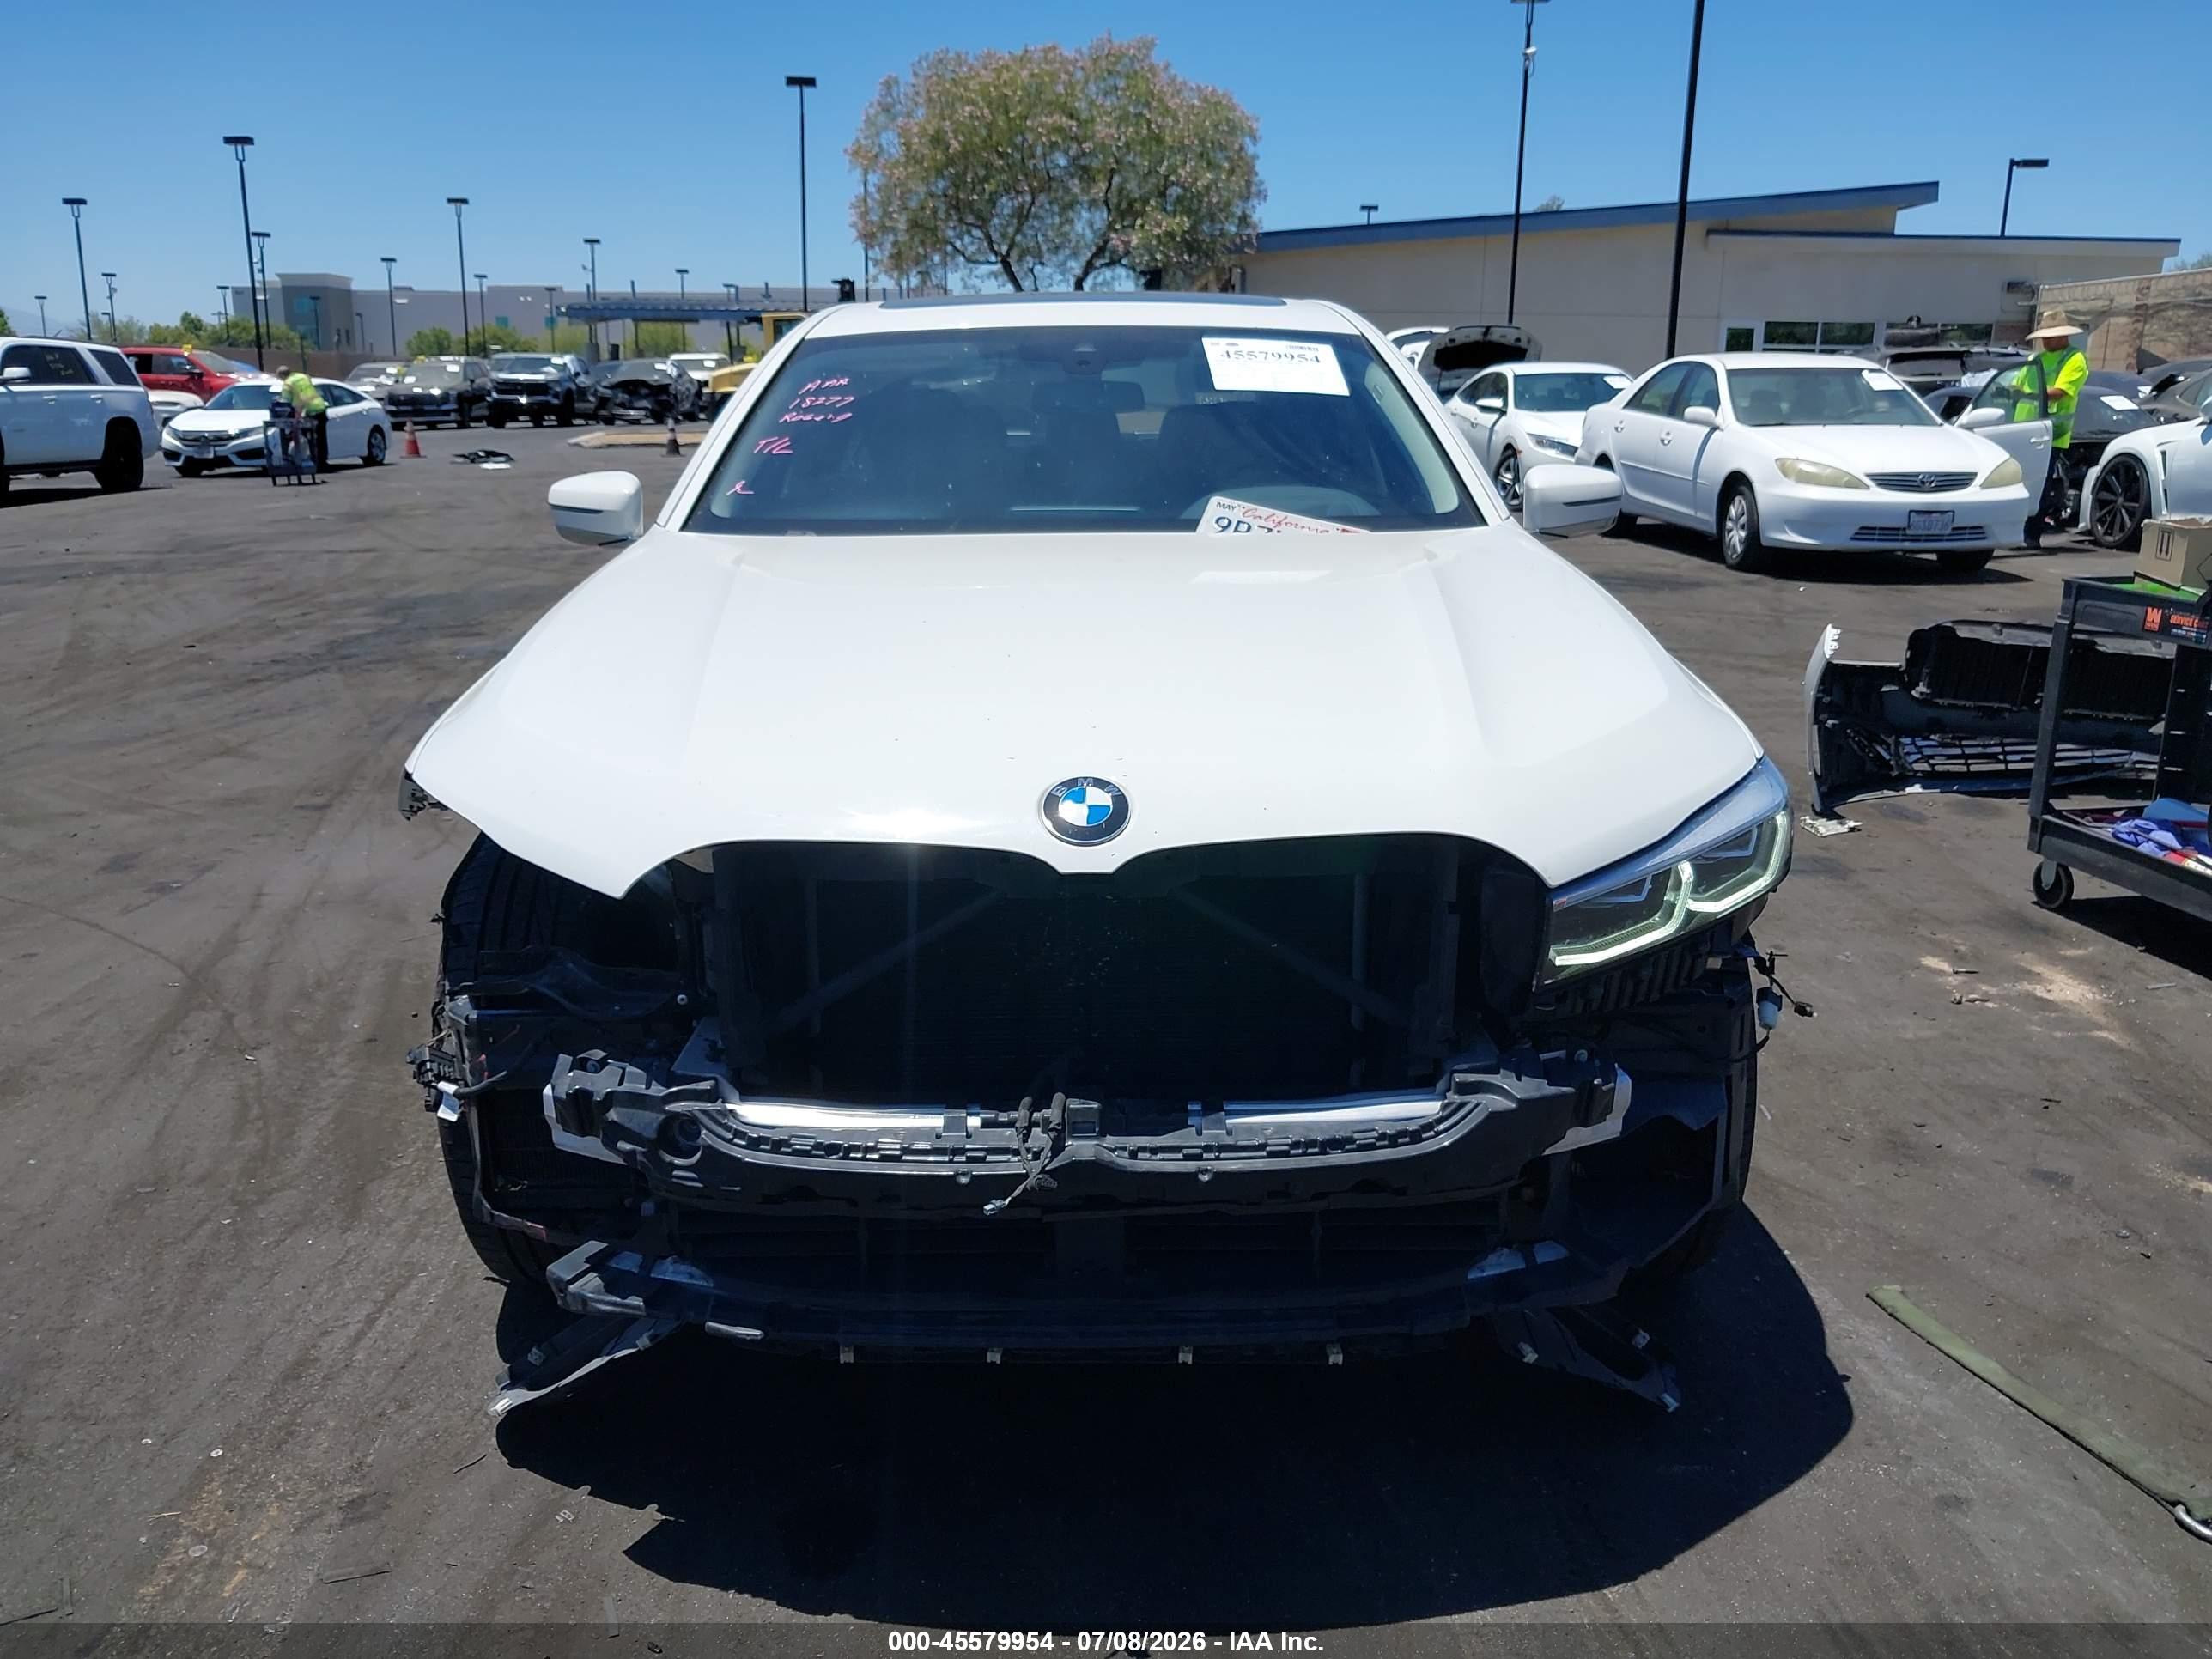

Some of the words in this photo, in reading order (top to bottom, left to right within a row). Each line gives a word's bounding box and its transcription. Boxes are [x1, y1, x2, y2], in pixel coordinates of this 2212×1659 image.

[1220, 350, 1321, 363] 45579954
[1216, 501, 1237, 514] MAY
[1242, 507, 1330, 533] California
[1050, 777, 1122, 797] BMW
